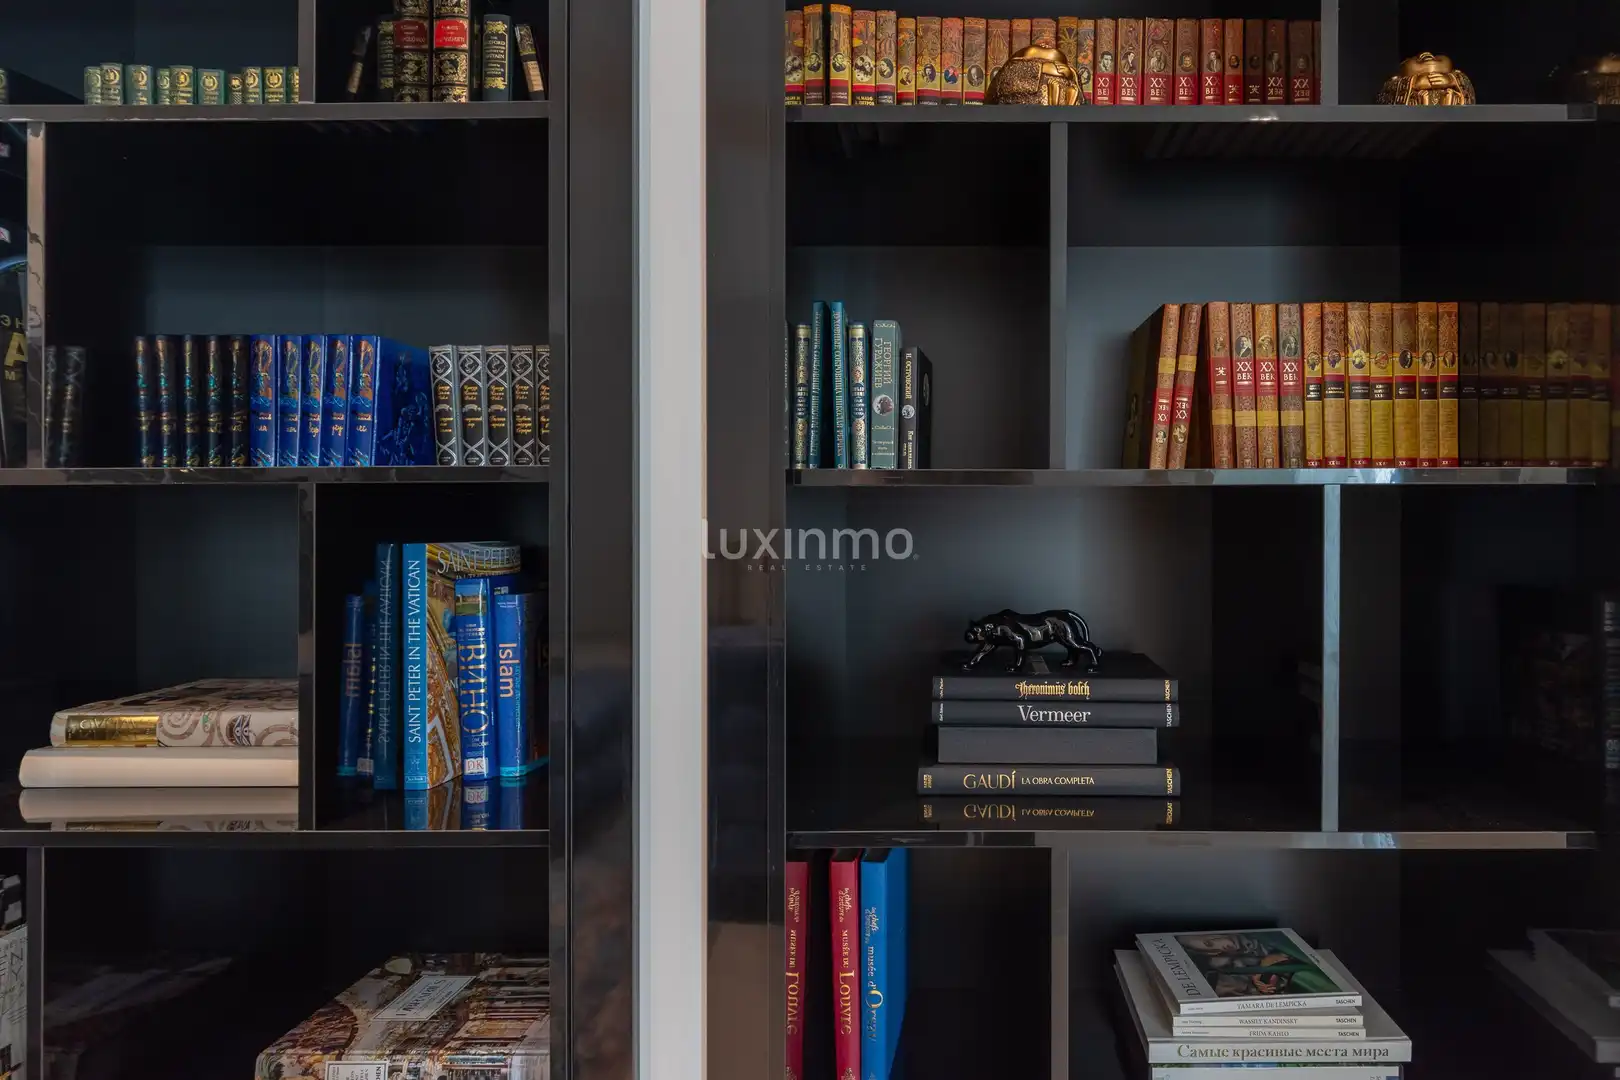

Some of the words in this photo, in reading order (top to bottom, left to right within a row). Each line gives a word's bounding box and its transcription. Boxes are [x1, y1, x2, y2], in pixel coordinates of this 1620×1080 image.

[1121, 77, 1138, 88] XX
[1150, 77, 1167, 88] XX
[834, 350, 842, 394] СОКРОВИЩА
[874, 338, 884, 388] ГУРДЖИЕВ
[883, 342, 892, 384] ГЕОРГИЙ
[1236, 362, 1252, 372] XX
[1260, 362, 1275, 372] XX
[1283, 362, 1298, 372] XX
[1237, 372, 1252, 380] ВЕК
[437, 547, 480, 574] SAINT
[408, 560, 421, 616] VATICAN
[408, 619, 421, 641] THE
[408, 646, 421, 660] IN
[498, 642, 519, 698] Islam
[408, 665, 421, 701] PETER
[458, 643, 489, 734] ВИНО
[1016, 704, 1091, 722] Vermeer
[408, 706, 421, 743] SAINT
[467, 761, 484, 772] DK
[963, 770, 1016, 789] GAUDÍ
[1022, 776, 1031, 785] LA
[1032, 776, 1052, 785] OBRA
[1054, 776, 1095, 785] COMPLETA
[841, 929, 850, 956] MUSÉE
[842, 957, 849, 968] DU
[868, 946, 876, 977] musée
[1181, 982, 1203, 996] DE
[1236, 1002, 1264, 1010] TAMARA
[1274, 1000, 1307, 1008] LEMPICKA
[1176, 1044, 1228, 1058] Самые
[1232, 1047, 1302, 1060] красивые
[1304, 1047, 1348, 1057] места
[1352, 1047, 1390, 1060] мира
